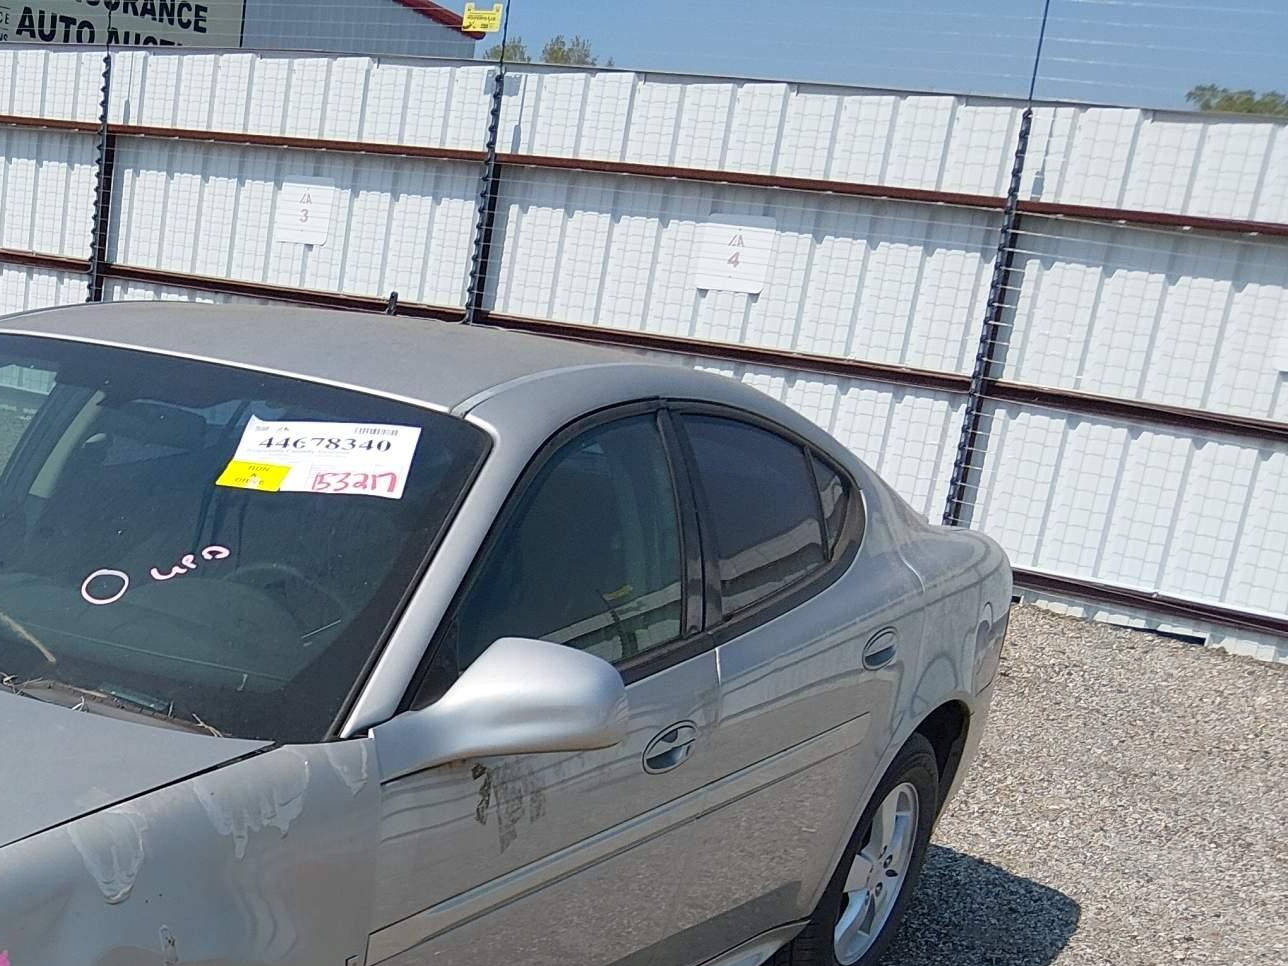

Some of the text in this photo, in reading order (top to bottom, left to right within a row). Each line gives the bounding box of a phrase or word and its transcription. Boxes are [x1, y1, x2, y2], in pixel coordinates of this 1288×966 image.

[16, 6, 95, 43] AUTO
[299, 208, 309, 223] 3
[727, 251, 740, 268] 4
[258, 436, 392, 453] 44678340
